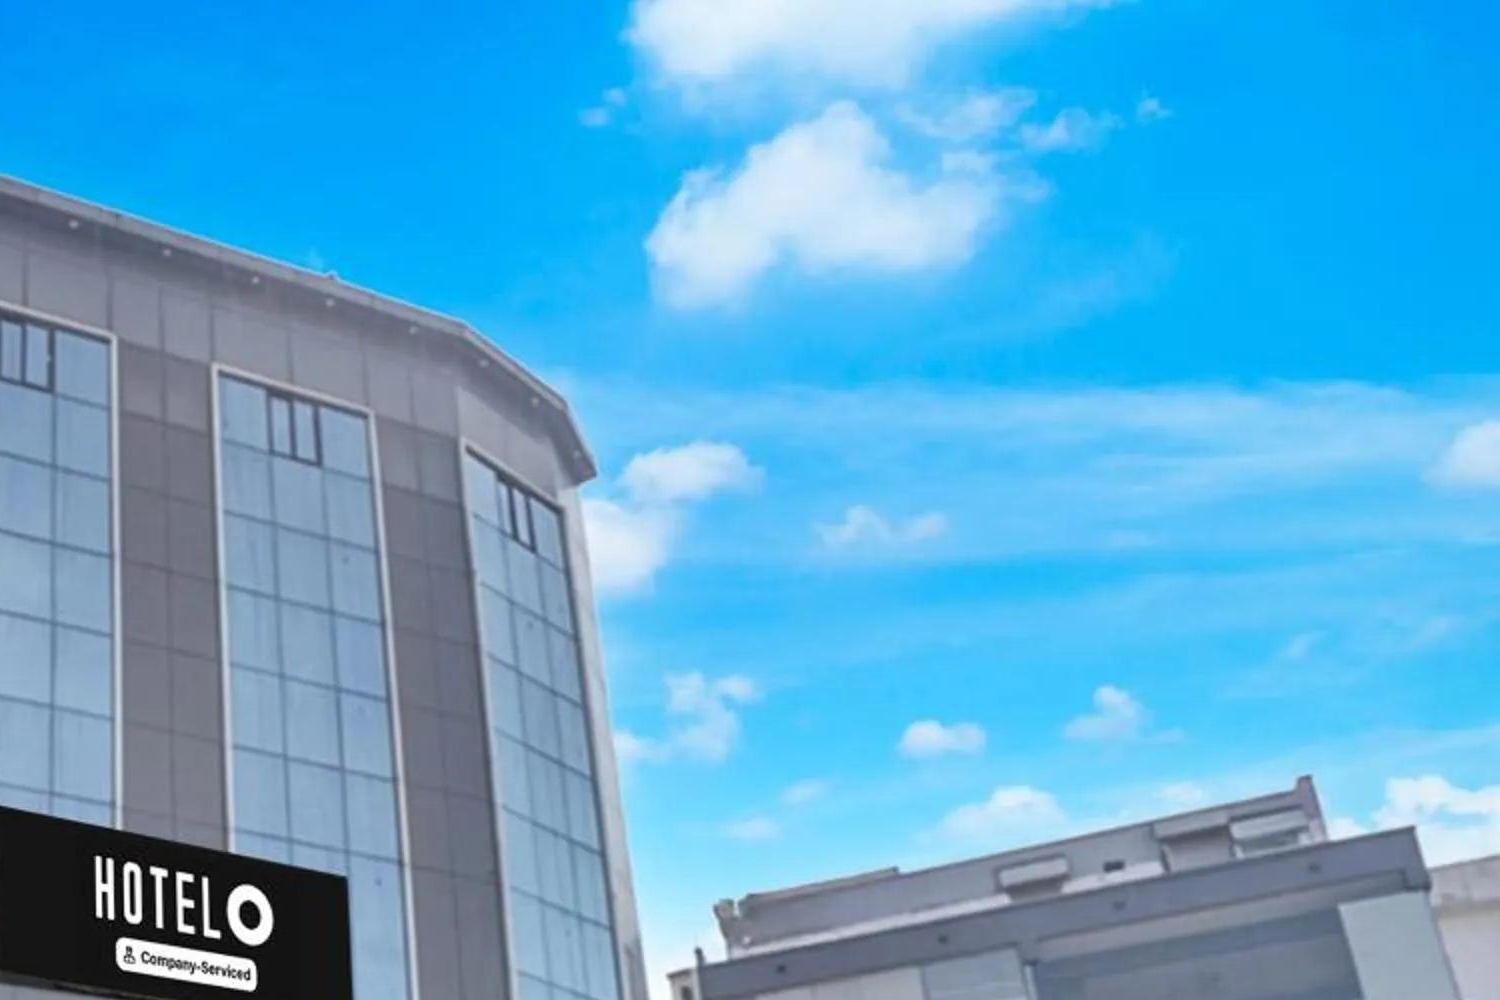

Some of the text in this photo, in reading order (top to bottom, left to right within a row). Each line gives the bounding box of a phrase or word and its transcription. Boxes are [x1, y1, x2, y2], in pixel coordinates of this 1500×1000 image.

[94, 855, 274, 946] HOTEL O
[140, 950, 251, 981] Company-Serviced
